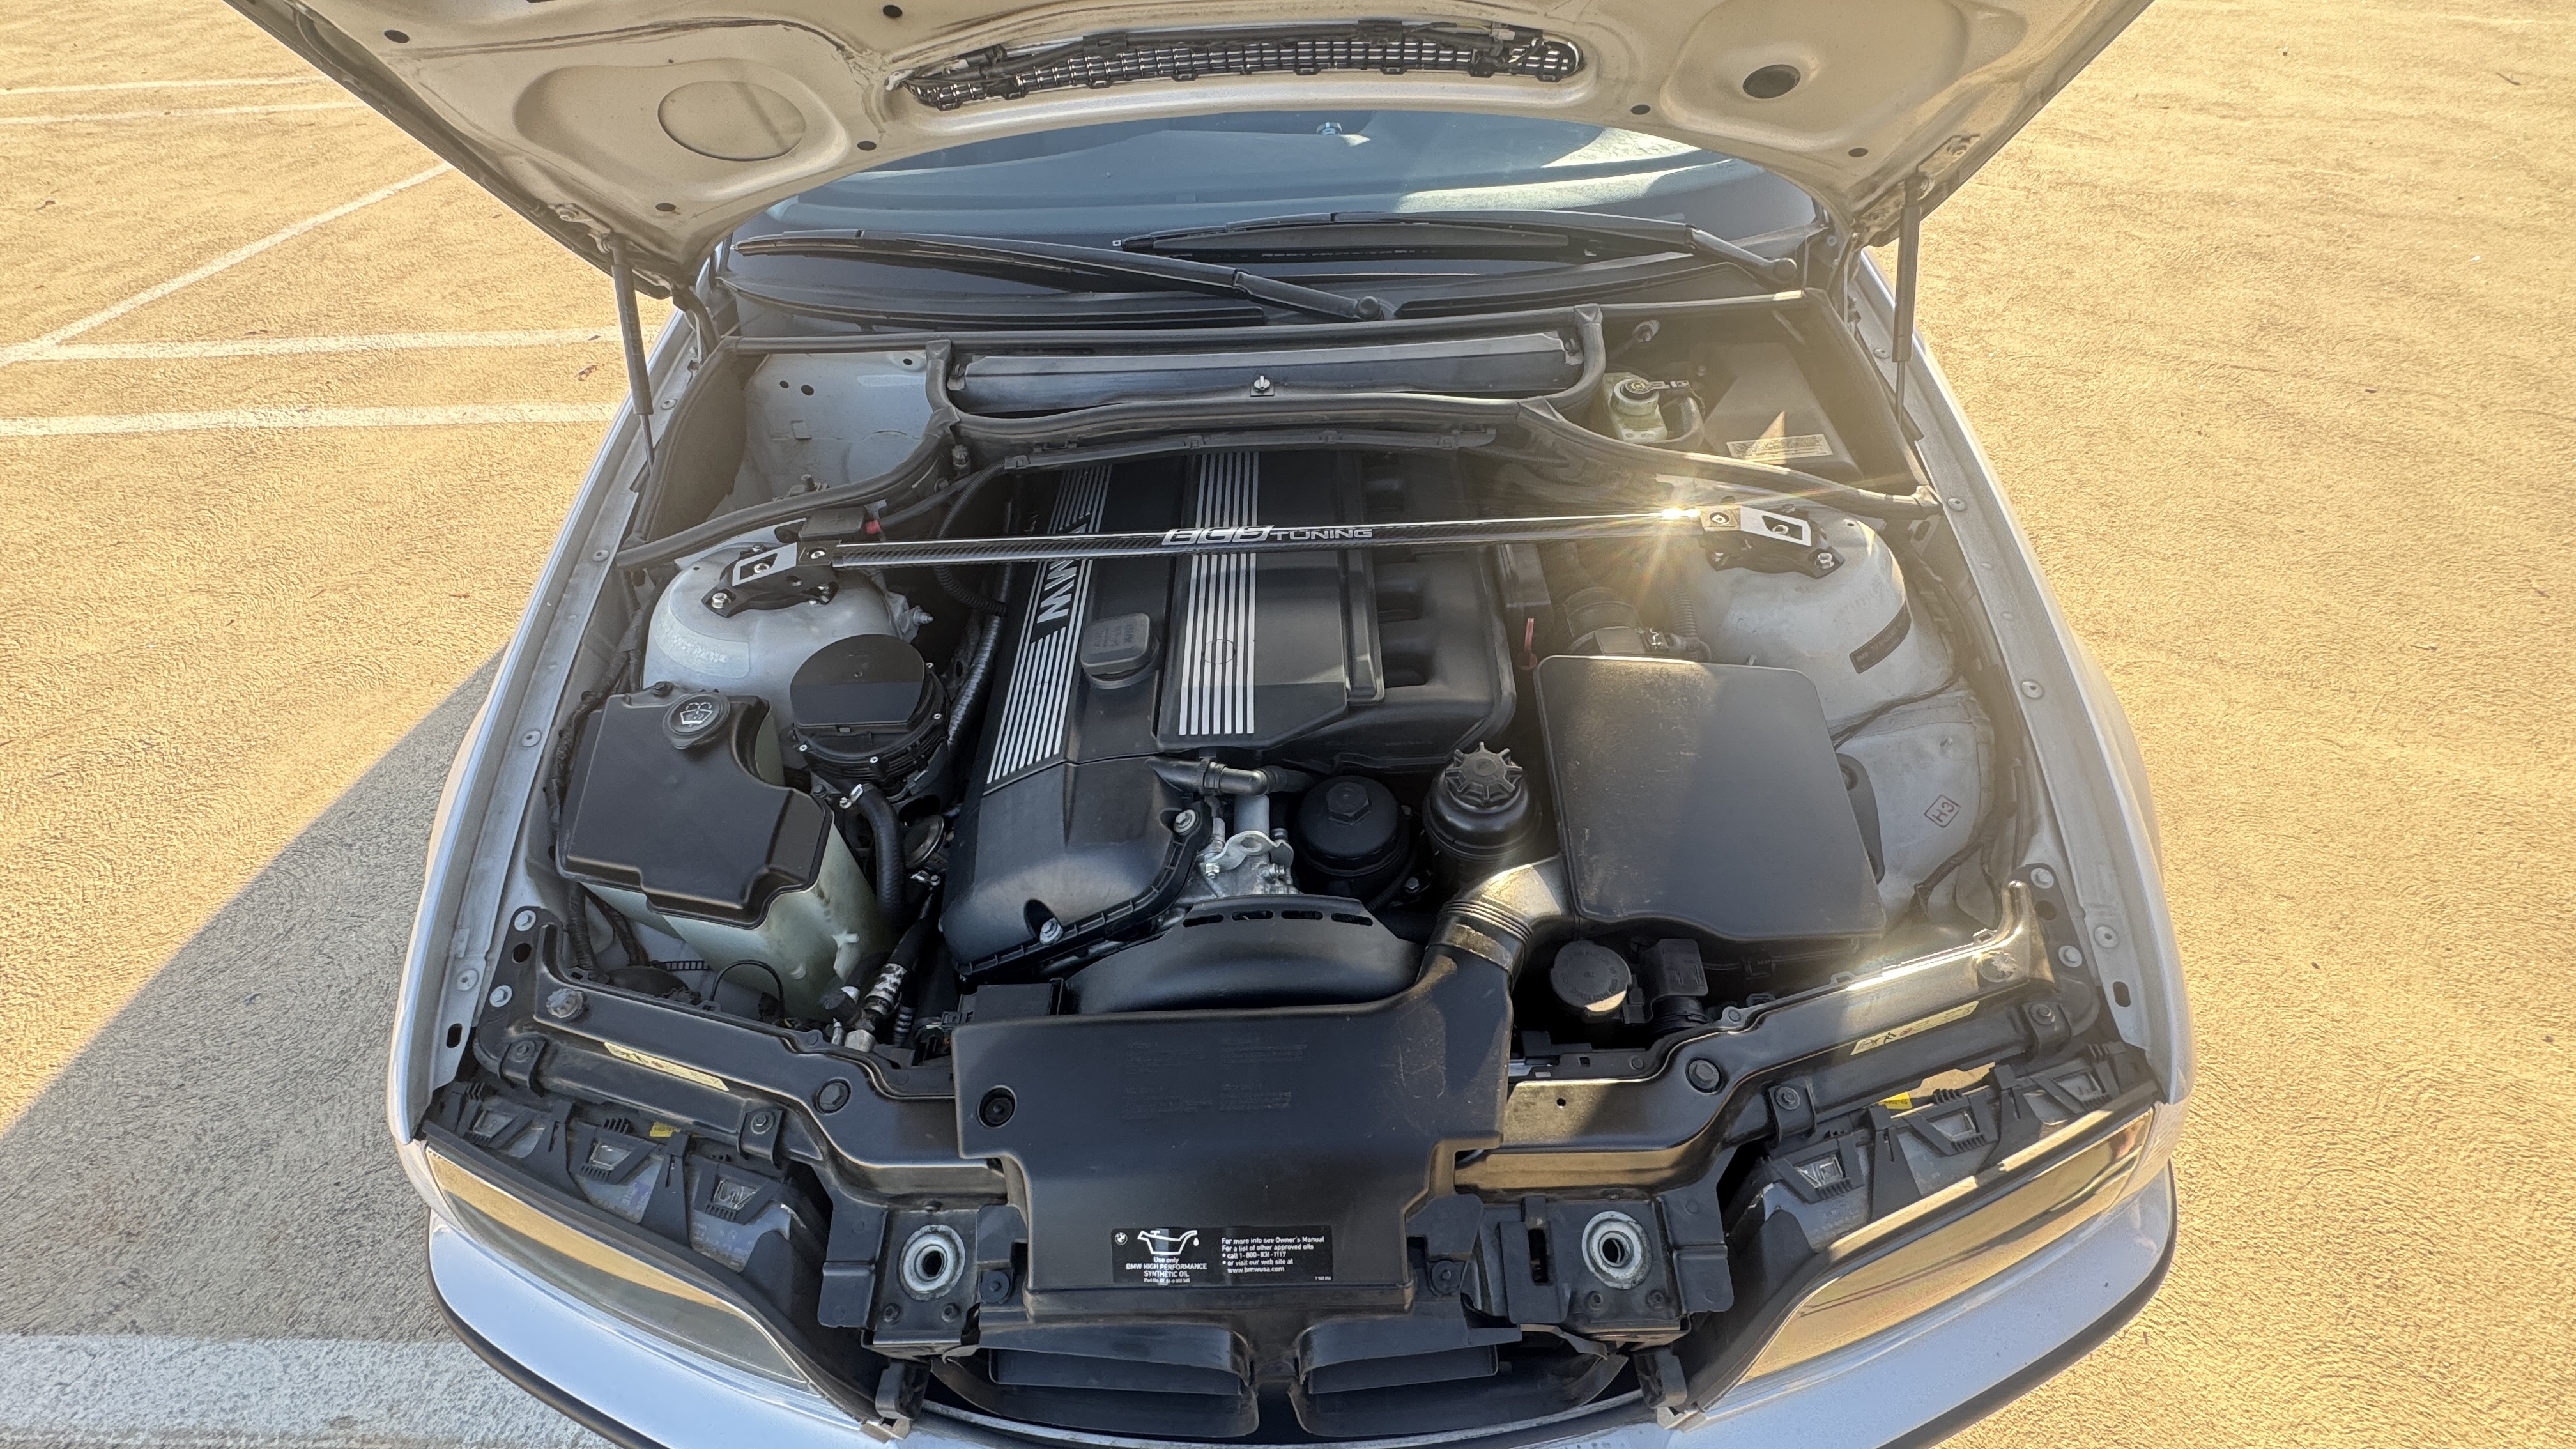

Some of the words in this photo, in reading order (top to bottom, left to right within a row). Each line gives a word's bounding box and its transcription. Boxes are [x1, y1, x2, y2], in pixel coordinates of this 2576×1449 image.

[1270, 528, 1373, 541] TUNING
[1036, 523, 1087, 624] MW
[1931, 801, 1955, 823] H3
